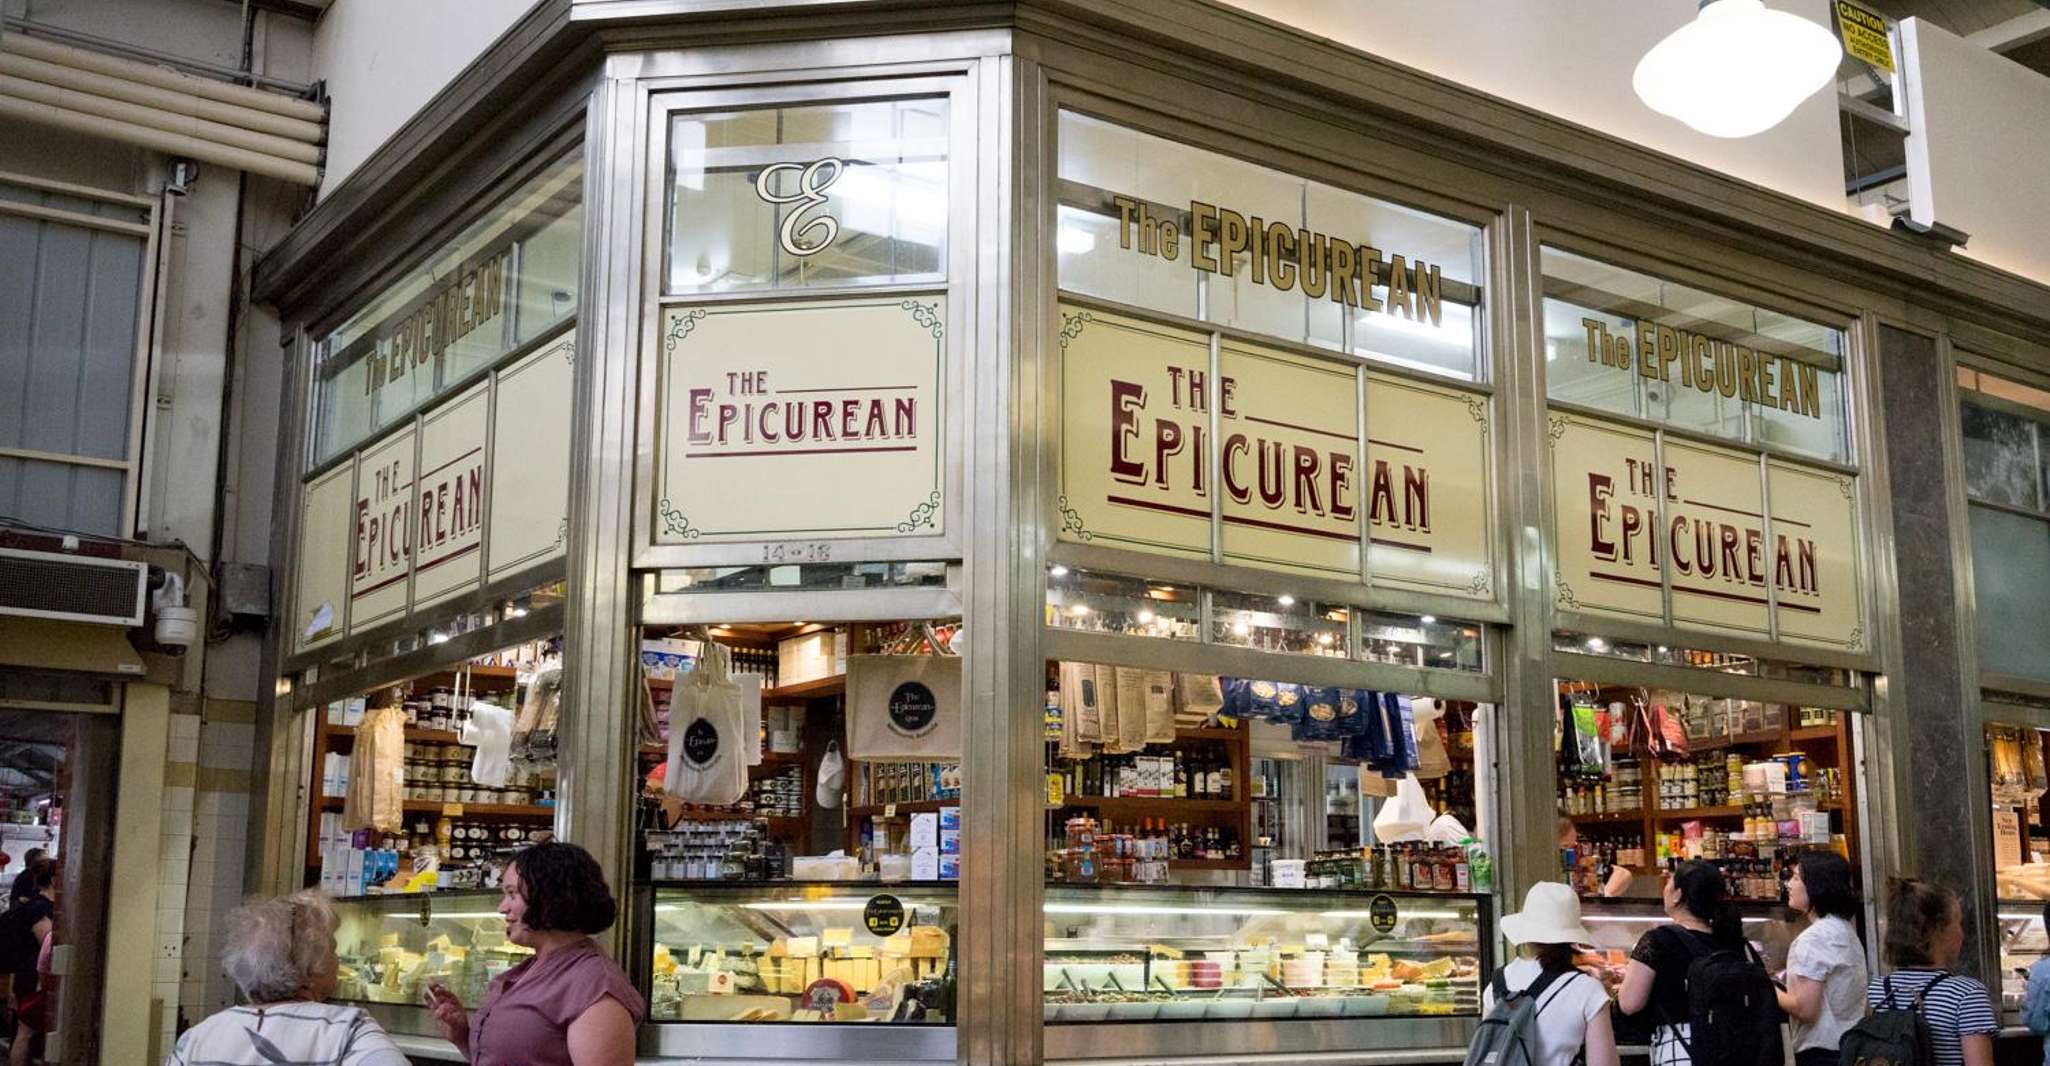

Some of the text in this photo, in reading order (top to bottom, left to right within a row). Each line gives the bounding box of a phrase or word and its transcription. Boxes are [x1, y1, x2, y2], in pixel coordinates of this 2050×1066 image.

[1840, 3, 1885, 34] CAUTION
[1843, 21, 1856, 34] NO
[1113, 195, 1443, 328] The EPICUREAN
[389, 254, 502, 384] EPICUREAN
[727, 371, 768, 396] THE
[1166, 366, 1238, 419] THE
[1582, 317, 1821, 419] The EPICUREAN
[687, 388, 918, 446] EPICUREAN
[375, 460, 400, 505] THE
[1109, 379, 1433, 535] EPICUREAN
[1625, 457, 1679, 502] THE
[354, 465, 482, 582] EPICUREAN
[1587, 472, 1821, 598] EPICUREAN
